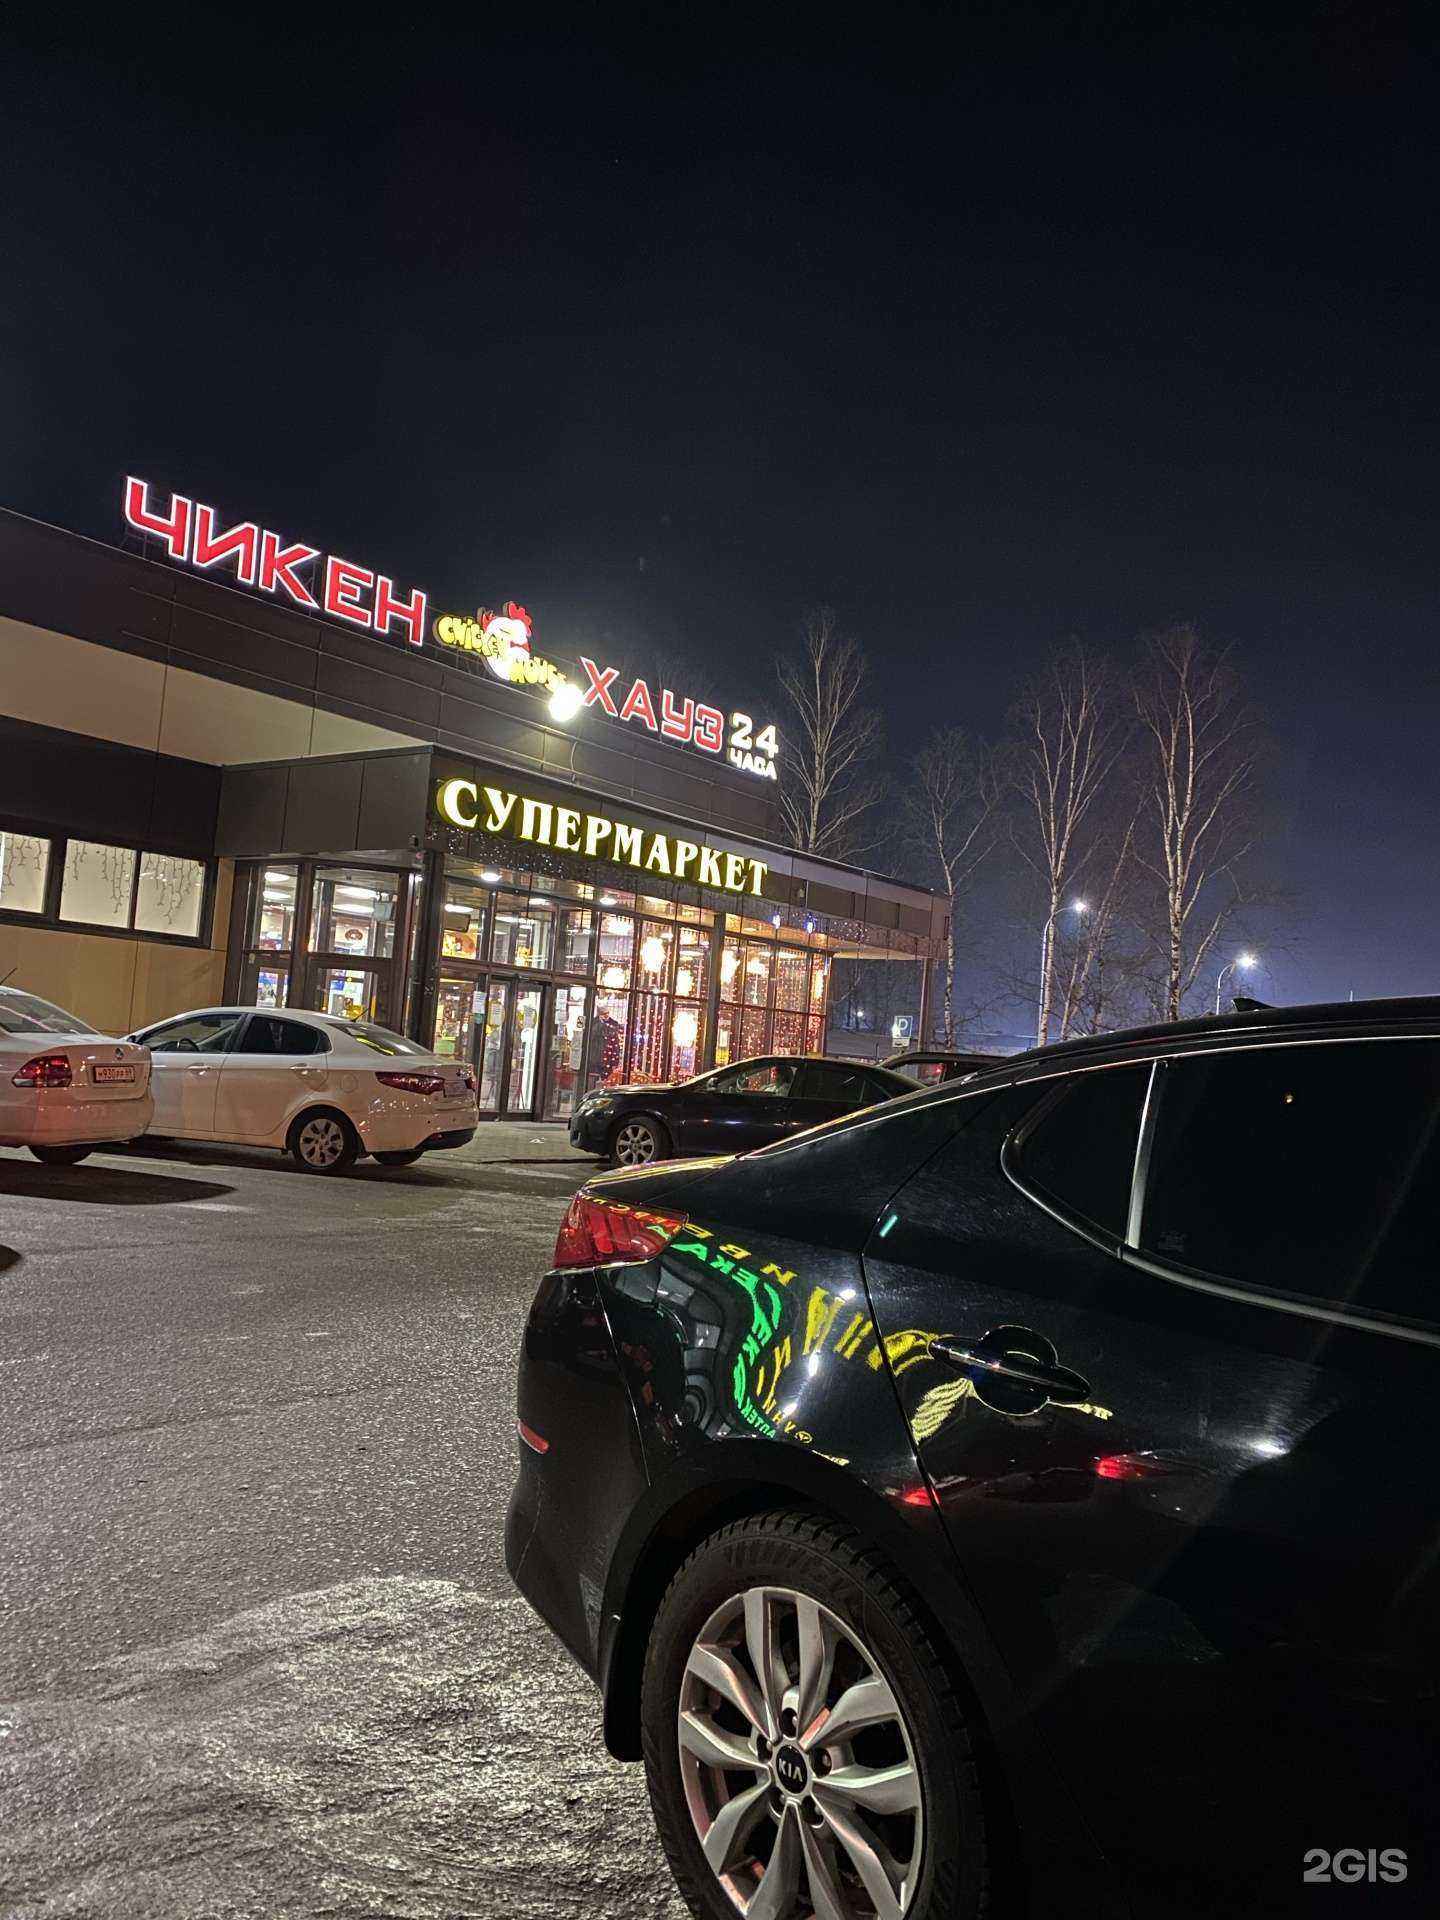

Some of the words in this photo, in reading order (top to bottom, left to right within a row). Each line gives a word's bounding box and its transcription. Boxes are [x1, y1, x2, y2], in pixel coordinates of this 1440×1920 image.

[125, 475, 427, 647] ЧИКЕН
[579, 656, 724, 753] ХАУЗ
[730, 712, 779, 758] 24
[442, 779, 768, 896] СУПЕРМАРКЕТ
[779, 1758, 803, 1782] KIA
